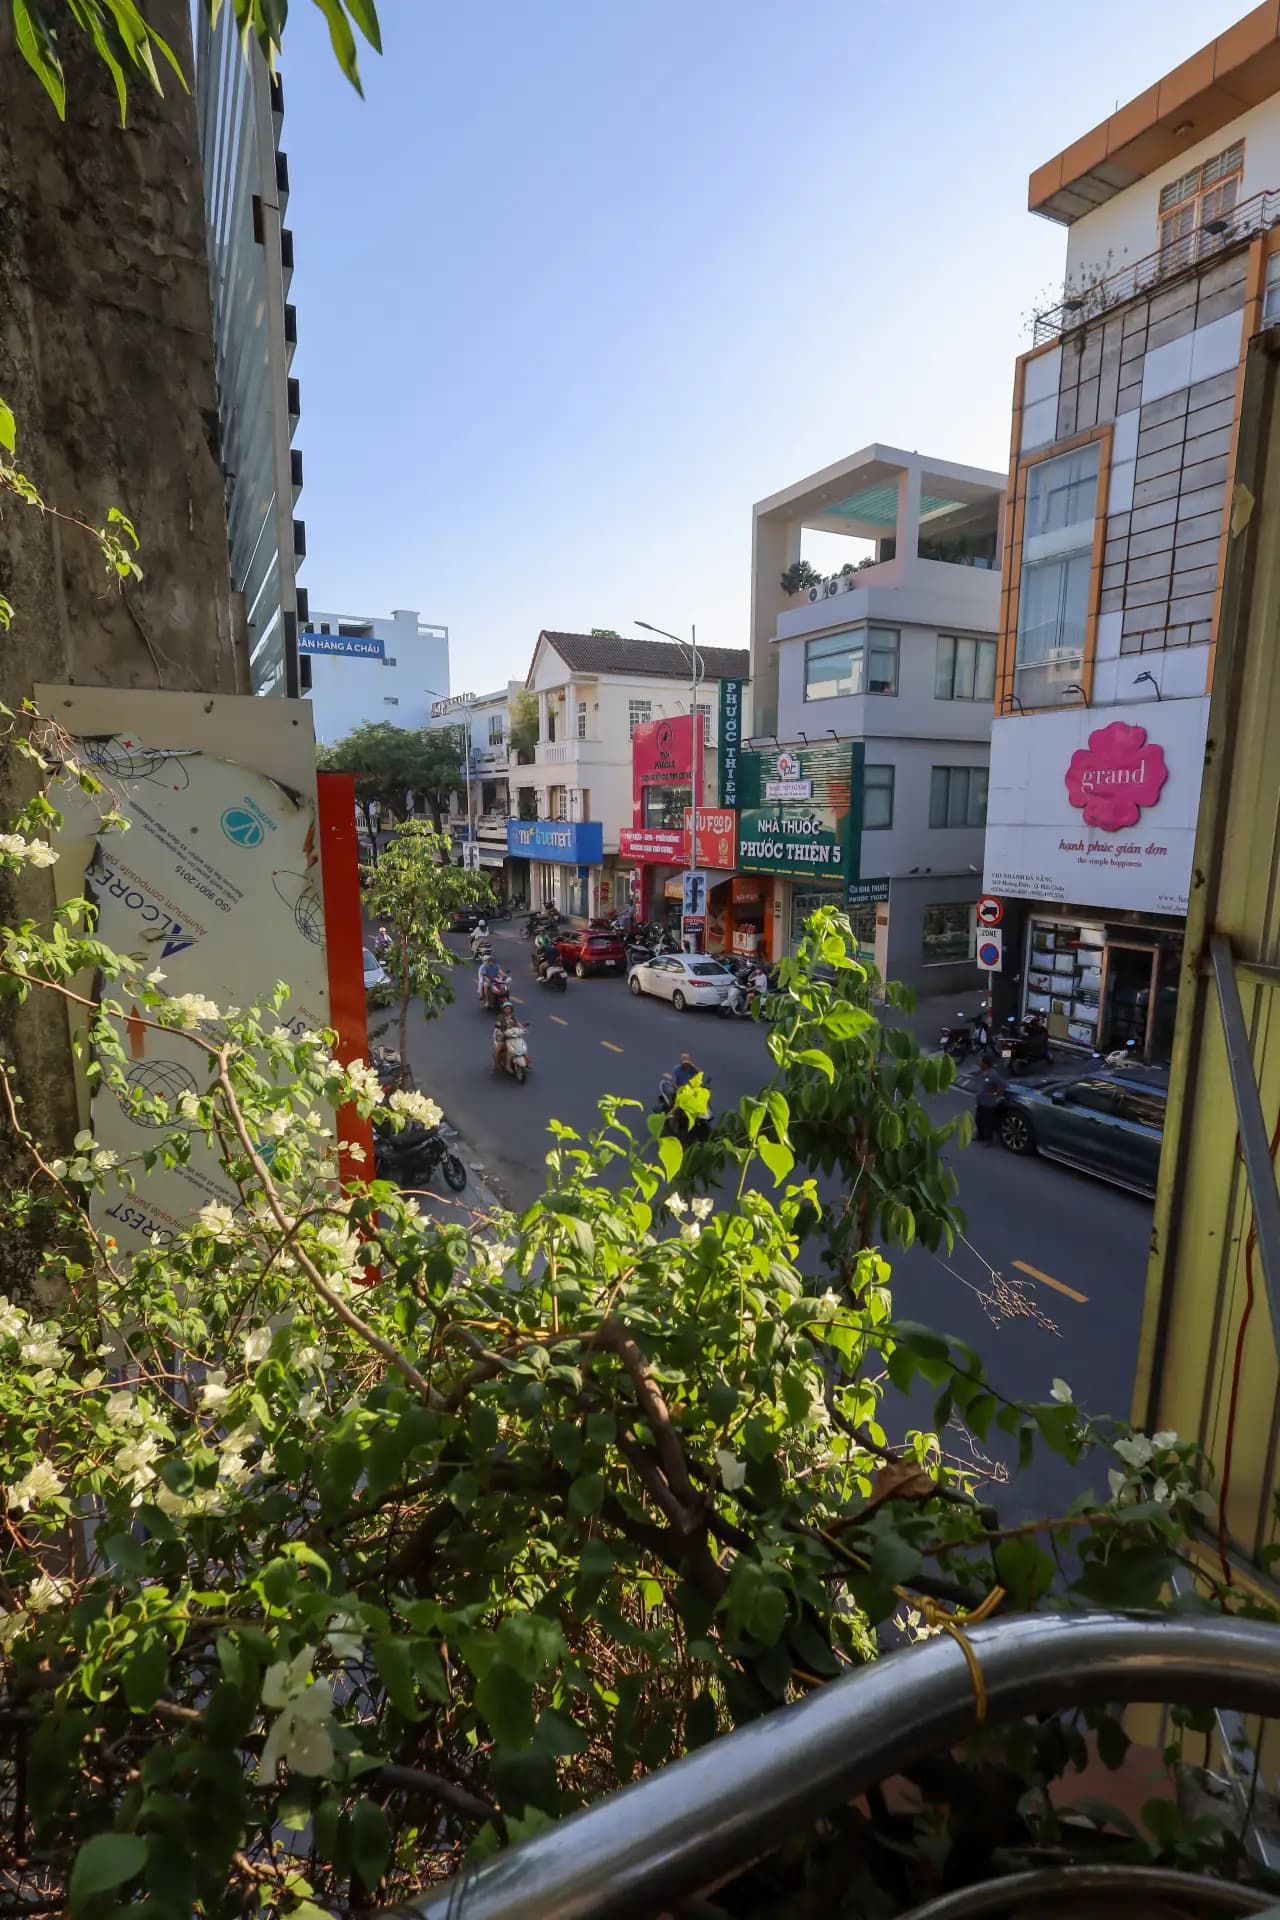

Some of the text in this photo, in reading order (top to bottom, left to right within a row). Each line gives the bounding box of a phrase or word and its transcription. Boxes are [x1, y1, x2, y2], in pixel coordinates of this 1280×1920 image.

[298, 637, 380, 654] ÂN HÀNG Á CHÂU
[1081, 760, 1145, 792] grand
[758, 814, 820, 834] NHÀ THUỐC
[740, 838, 841, 864] PHƯỚC THIỆN 5
[119, 864, 164, 901] composite
[174, 865, 232, 913] ISO 9001:2015
